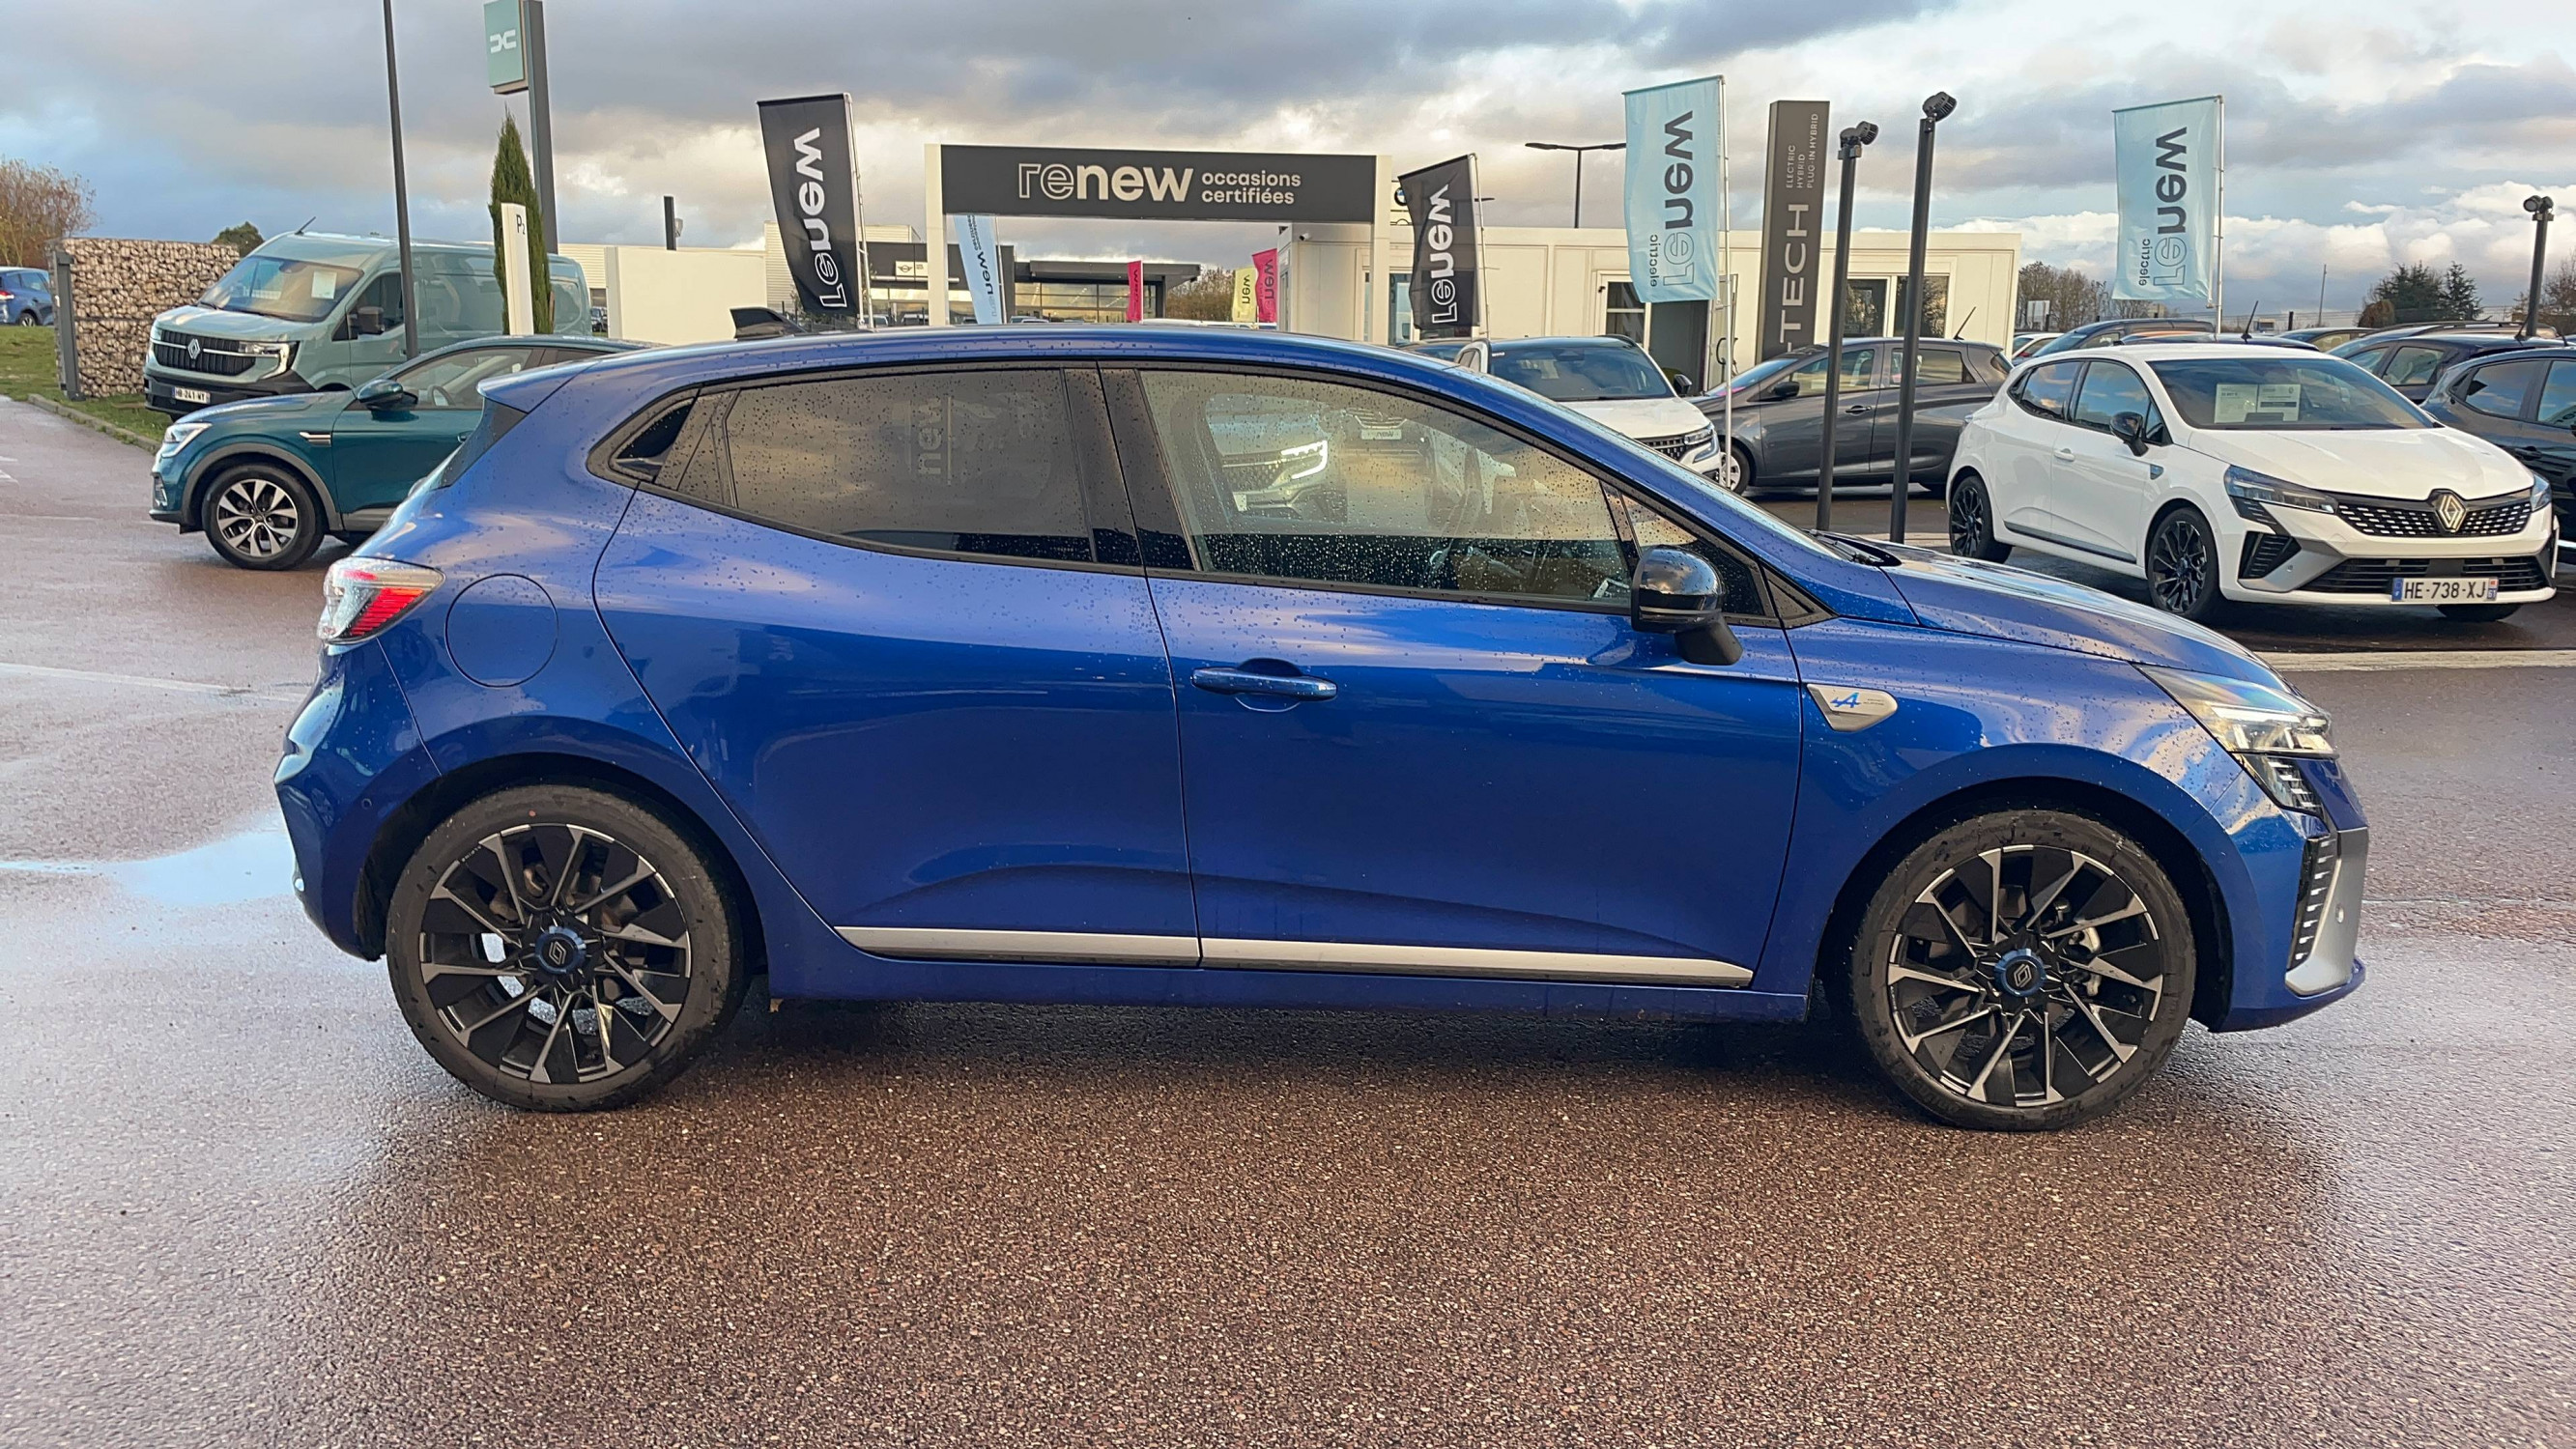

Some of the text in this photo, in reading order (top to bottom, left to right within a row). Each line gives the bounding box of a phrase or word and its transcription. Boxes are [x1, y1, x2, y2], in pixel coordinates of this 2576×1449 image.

[1786, 145, 1796, 188] ELECTRIC
[1807, 113, 1818, 188] PLUG-IN HYBRID
[1018, 163, 1193, 202] renew
[1201, 170, 1301, 186] occasions
[1796, 154, 1806, 188] HYBRID
[1201, 187, 1295, 204] certifiées
[2404, 582, 2486, 599] HE-738-XJ
